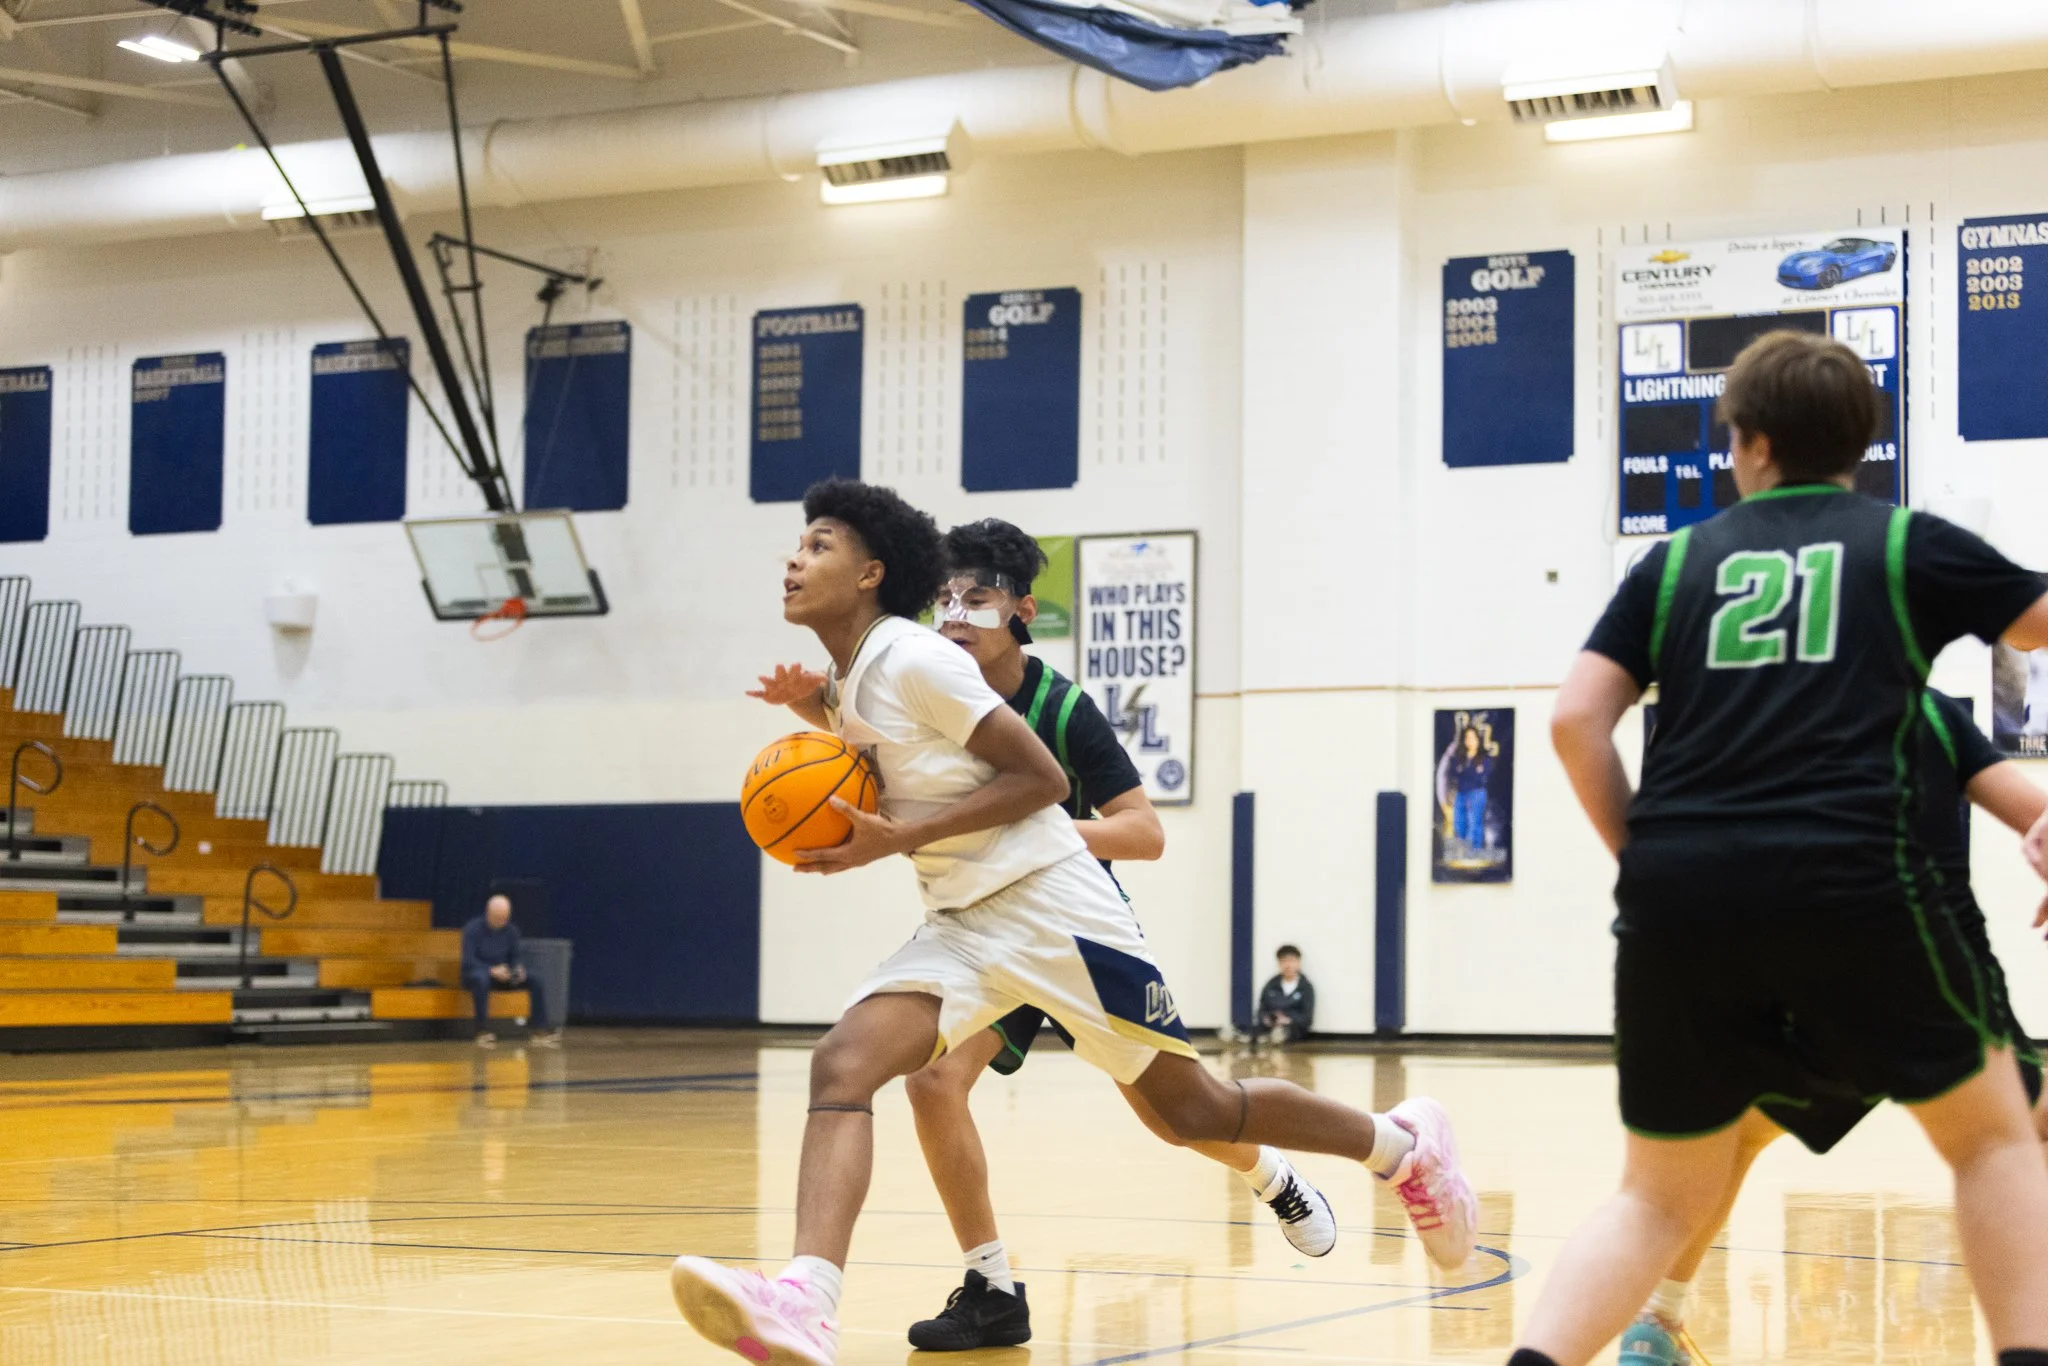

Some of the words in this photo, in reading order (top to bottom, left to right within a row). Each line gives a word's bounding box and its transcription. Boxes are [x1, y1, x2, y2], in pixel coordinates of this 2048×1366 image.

[1470, 266, 1546, 292] GOLF
[1622, 266, 1714, 283] CENTURY
[758, 311, 859, 338] FOOTBALL
[988, 302, 1055, 327] GOLF
[1624, 374, 1726, 402] LIGHTNING
[1623, 455, 1668, 474] FOULS
[1709, 452, 1734, 470] PLA
[1860, 443, 1896, 462] ULS
[1622, 514, 1668, 534] SCORE
[1089, 586, 1131, 605] WHO
[1135, 583, 1186, 604] PLAYS
[1706, 541, 1844, 669] 21
[1092, 612, 1116, 642] IN
[1125, 609, 1181, 641] THIS
[1087, 644, 1186, 678] HOUSE?
